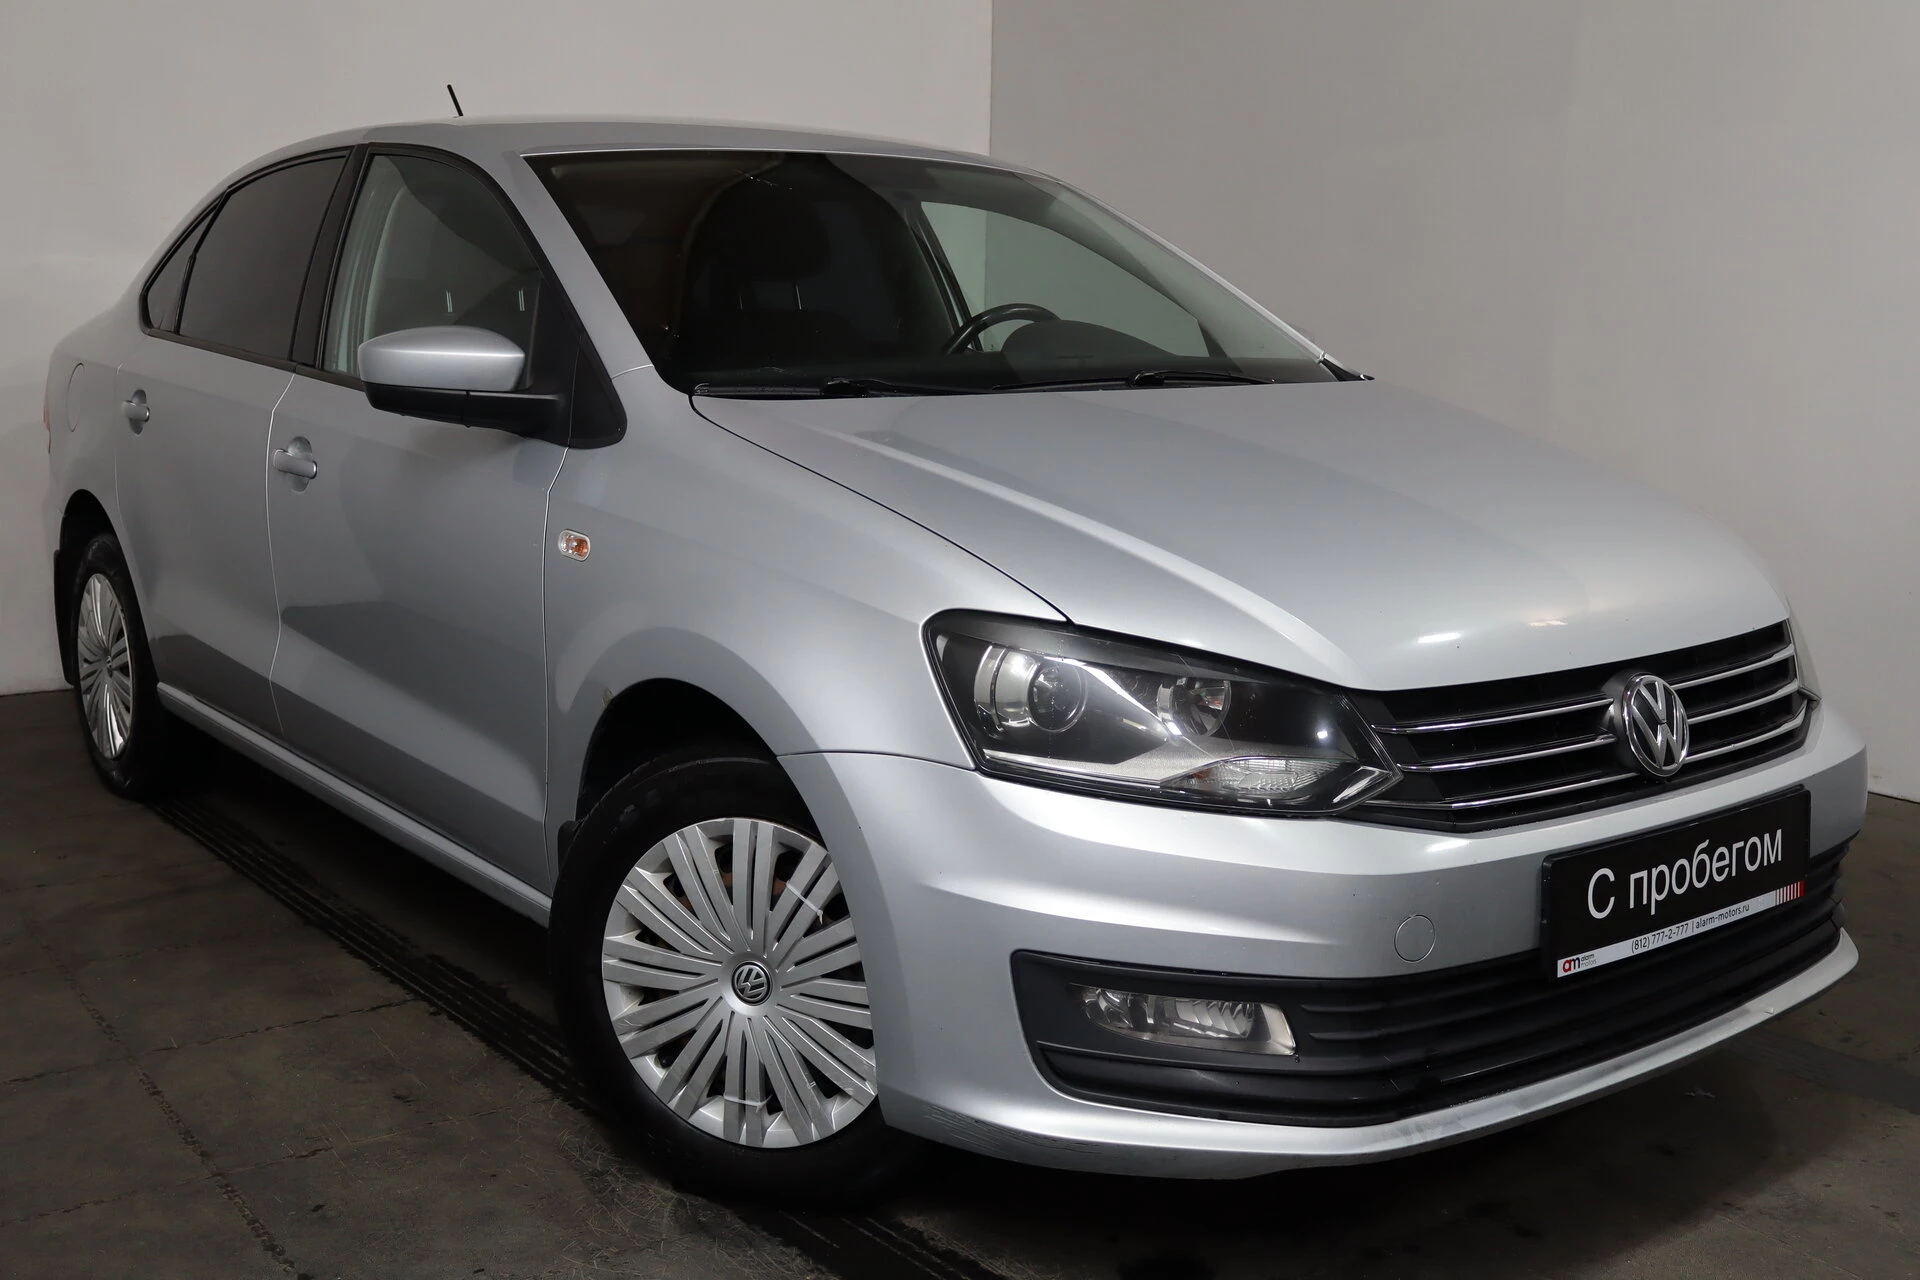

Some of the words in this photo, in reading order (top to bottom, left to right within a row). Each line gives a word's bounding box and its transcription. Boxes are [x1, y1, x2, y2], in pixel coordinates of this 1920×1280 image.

[1627, 677, 1687, 773] VW
[1587, 868, 1615, 919] С
[1630, 829, 1782, 915] пробегом
[1631, 937, 1650, 954] (812)
[1652, 923, 1689, 945] 777-2-777
[1695, 904, 1750, 929] alarm-motors.ru
